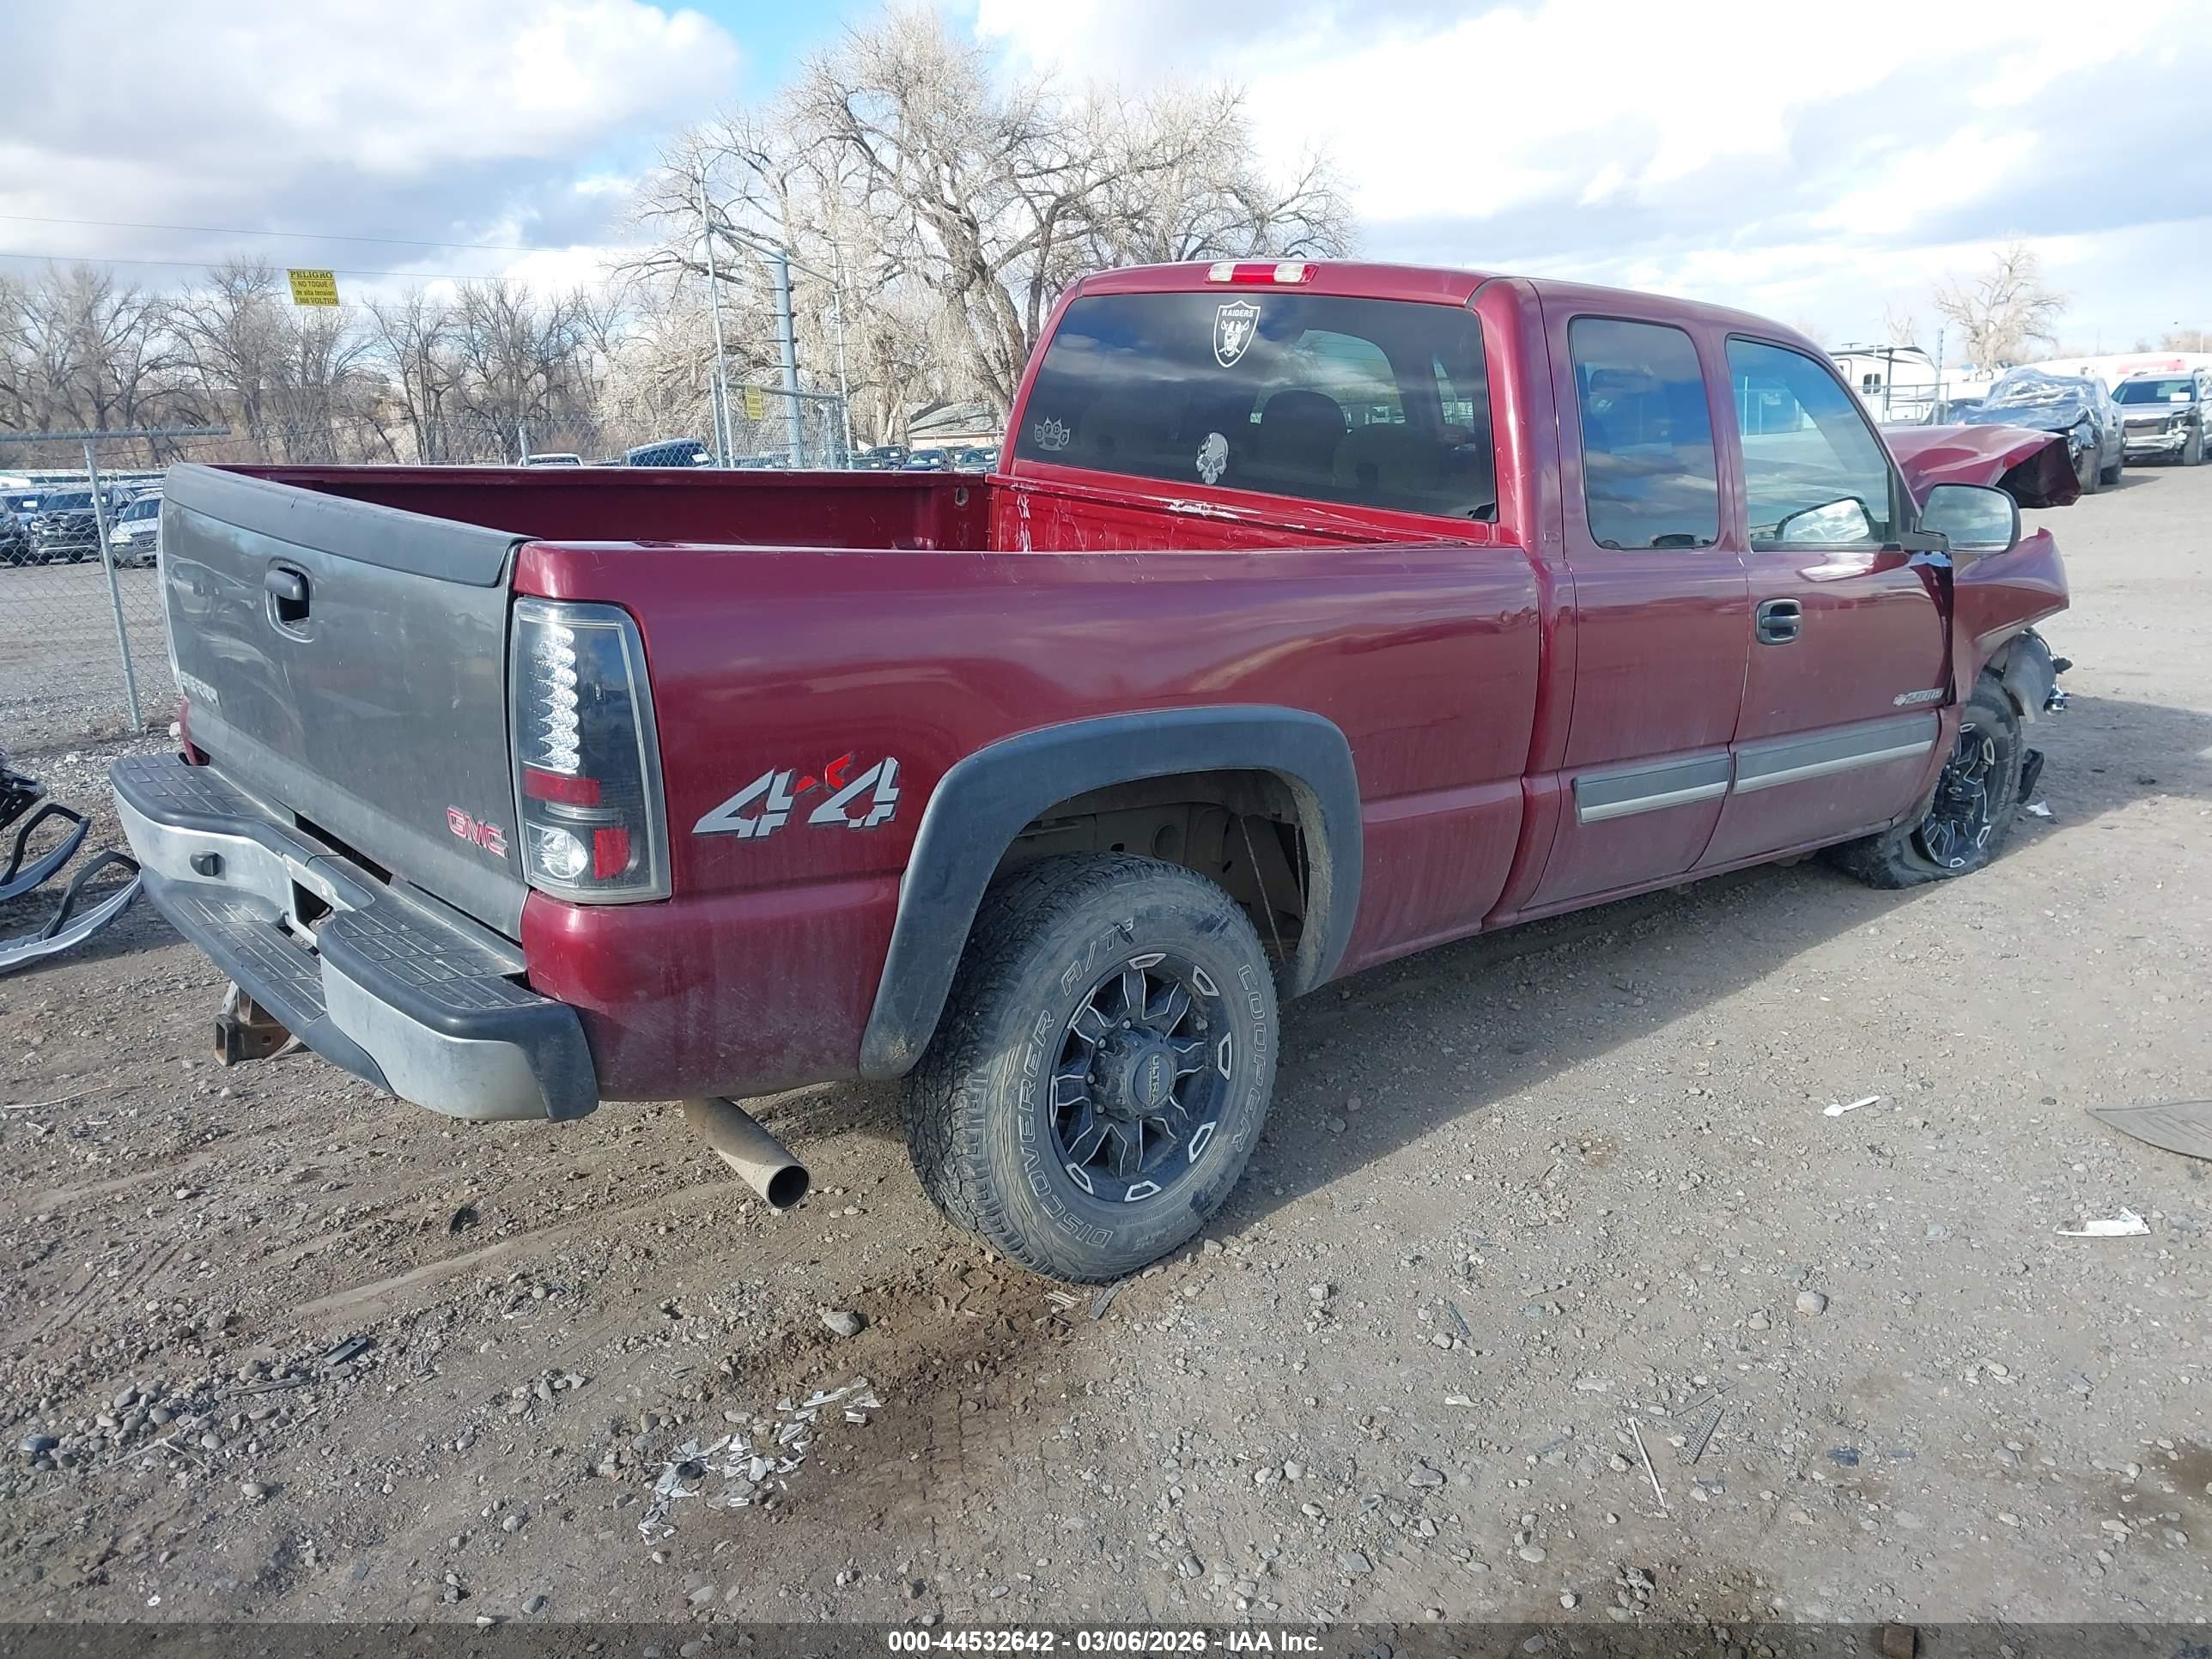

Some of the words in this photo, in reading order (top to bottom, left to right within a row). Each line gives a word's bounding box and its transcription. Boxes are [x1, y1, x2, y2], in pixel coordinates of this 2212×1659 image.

[1221, 308, 1255, 318] RAIDERS
[447, 805, 509, 860] GMC
[1152, 1054, 1160, 1106] ULTRA
[1231, 964, 1268, 1153] COOPER
[1018, 1008, 1115, 1249] DISCOVERER
